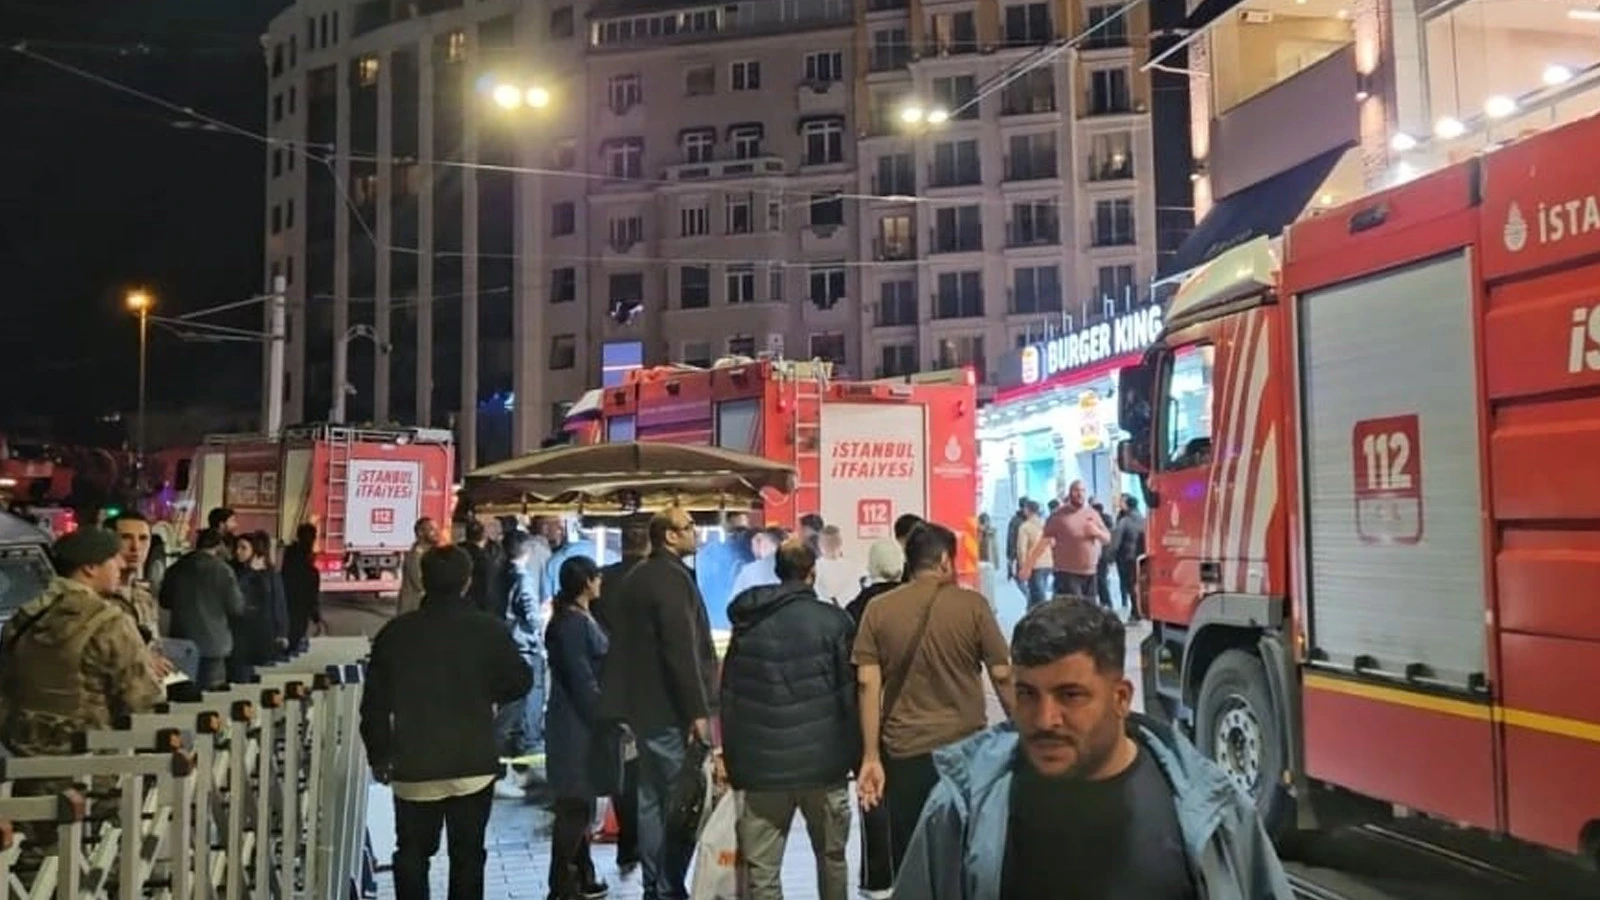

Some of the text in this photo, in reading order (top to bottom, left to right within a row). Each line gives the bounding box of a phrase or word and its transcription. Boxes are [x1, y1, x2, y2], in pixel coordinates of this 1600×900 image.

[1047, 322, 1111, 374] BURGER
[1114, 304, 1163, 354] KING
[832, 441, 915, 458] İSTANBUL
[1362, 430, 1412, 490] 112
[374, 511, 391, 522] 112
[861, 503, 888, 523] 112
